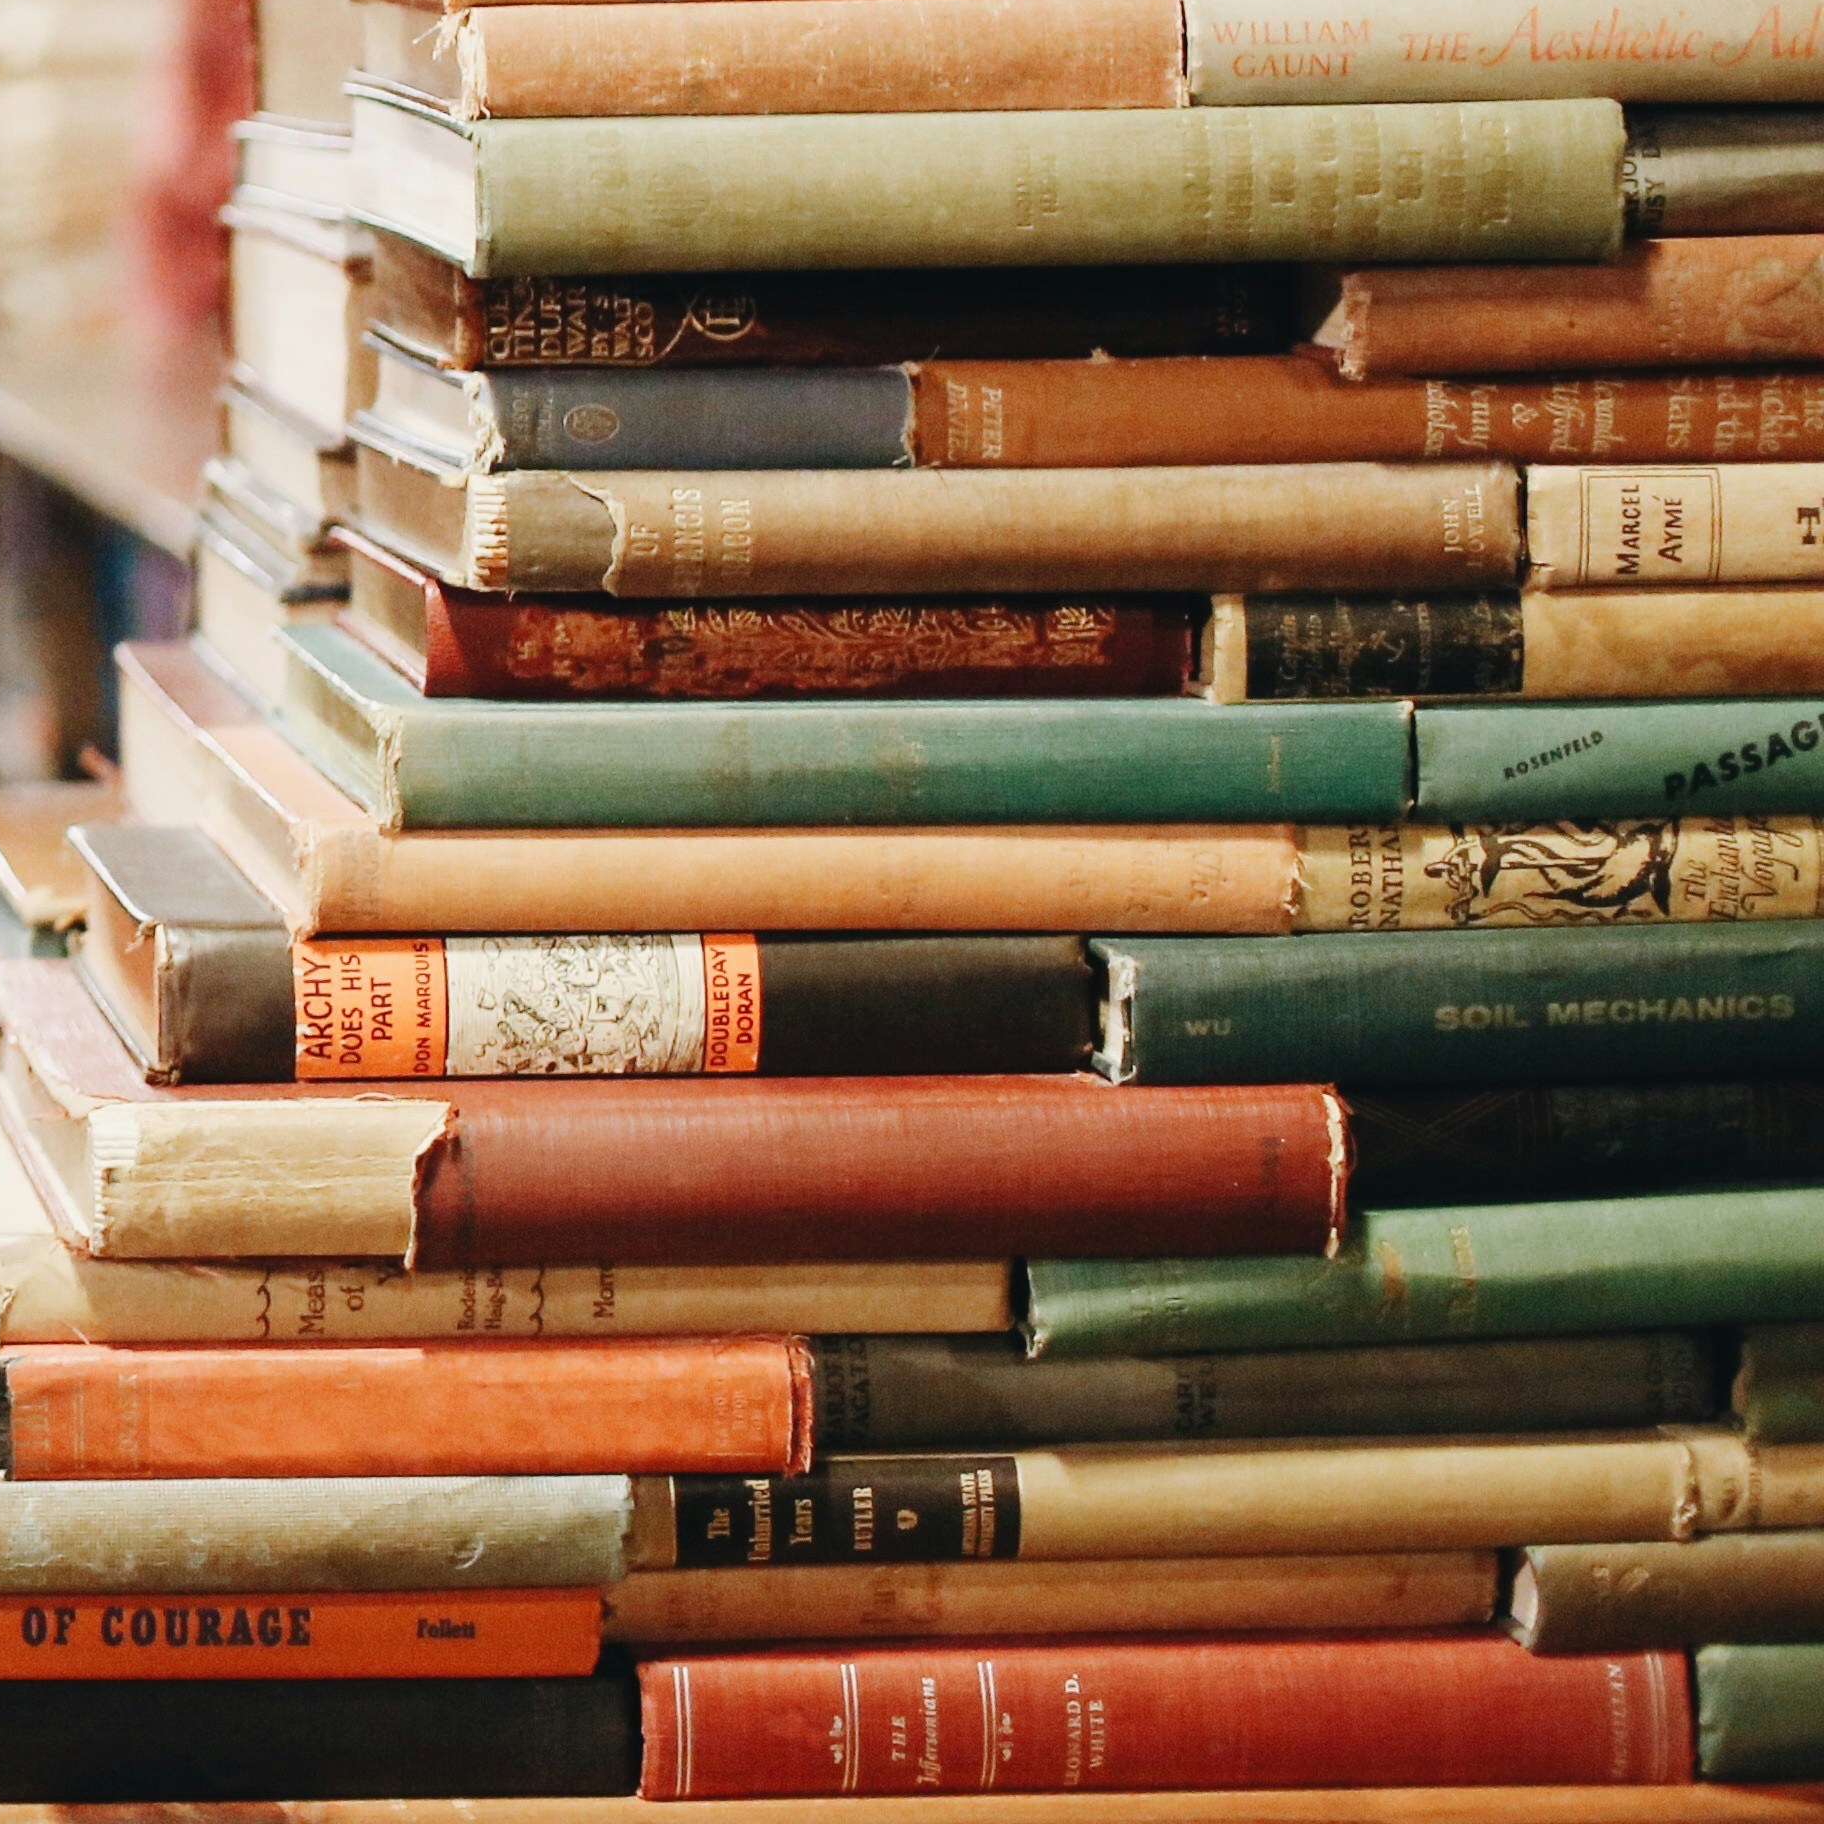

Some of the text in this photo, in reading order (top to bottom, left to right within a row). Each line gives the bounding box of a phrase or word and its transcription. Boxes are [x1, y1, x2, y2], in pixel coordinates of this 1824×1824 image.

[1212, 19, 1372, 46] WILLIAM
[1401, 32, 1471, 64] THE
[1480, 6, 1706, 68] Aesthetic
[1231, 51, 1355, 79] GAUNT
[1615, 484, 1641, 575] MARCEL
[1658, 496, 1684, 564] AYMÉ
[1502, 729, 1606, 781] ROSENFELD
[340, 951, 364, 995] HIS
[299, 956, 334, 1063] ARCHY
[340, 1003, 365, 1067] DOES
[368, 976, 395, 1043] PART
[413, 941, 433, 1075] DON MARQUIS
[708, 945, 727, 1068] DOUBLEDAY
[734, 970, 753, 1047] DORAN
[1184, 1016, 1234, 1039] WU
[1434, 991, 1798, 1035] SOIL MECHANICS
[789, 1498, 815, 1548] Years
[852, 1485, 877, 1552] BUTLER
[20, 1608, 76, 1649] OF
[98, 1606, 313, 1649] COURAGE
[889, 1714, 908, 1763] THE
[1088, 1697, 1105, 1771] WHITE
